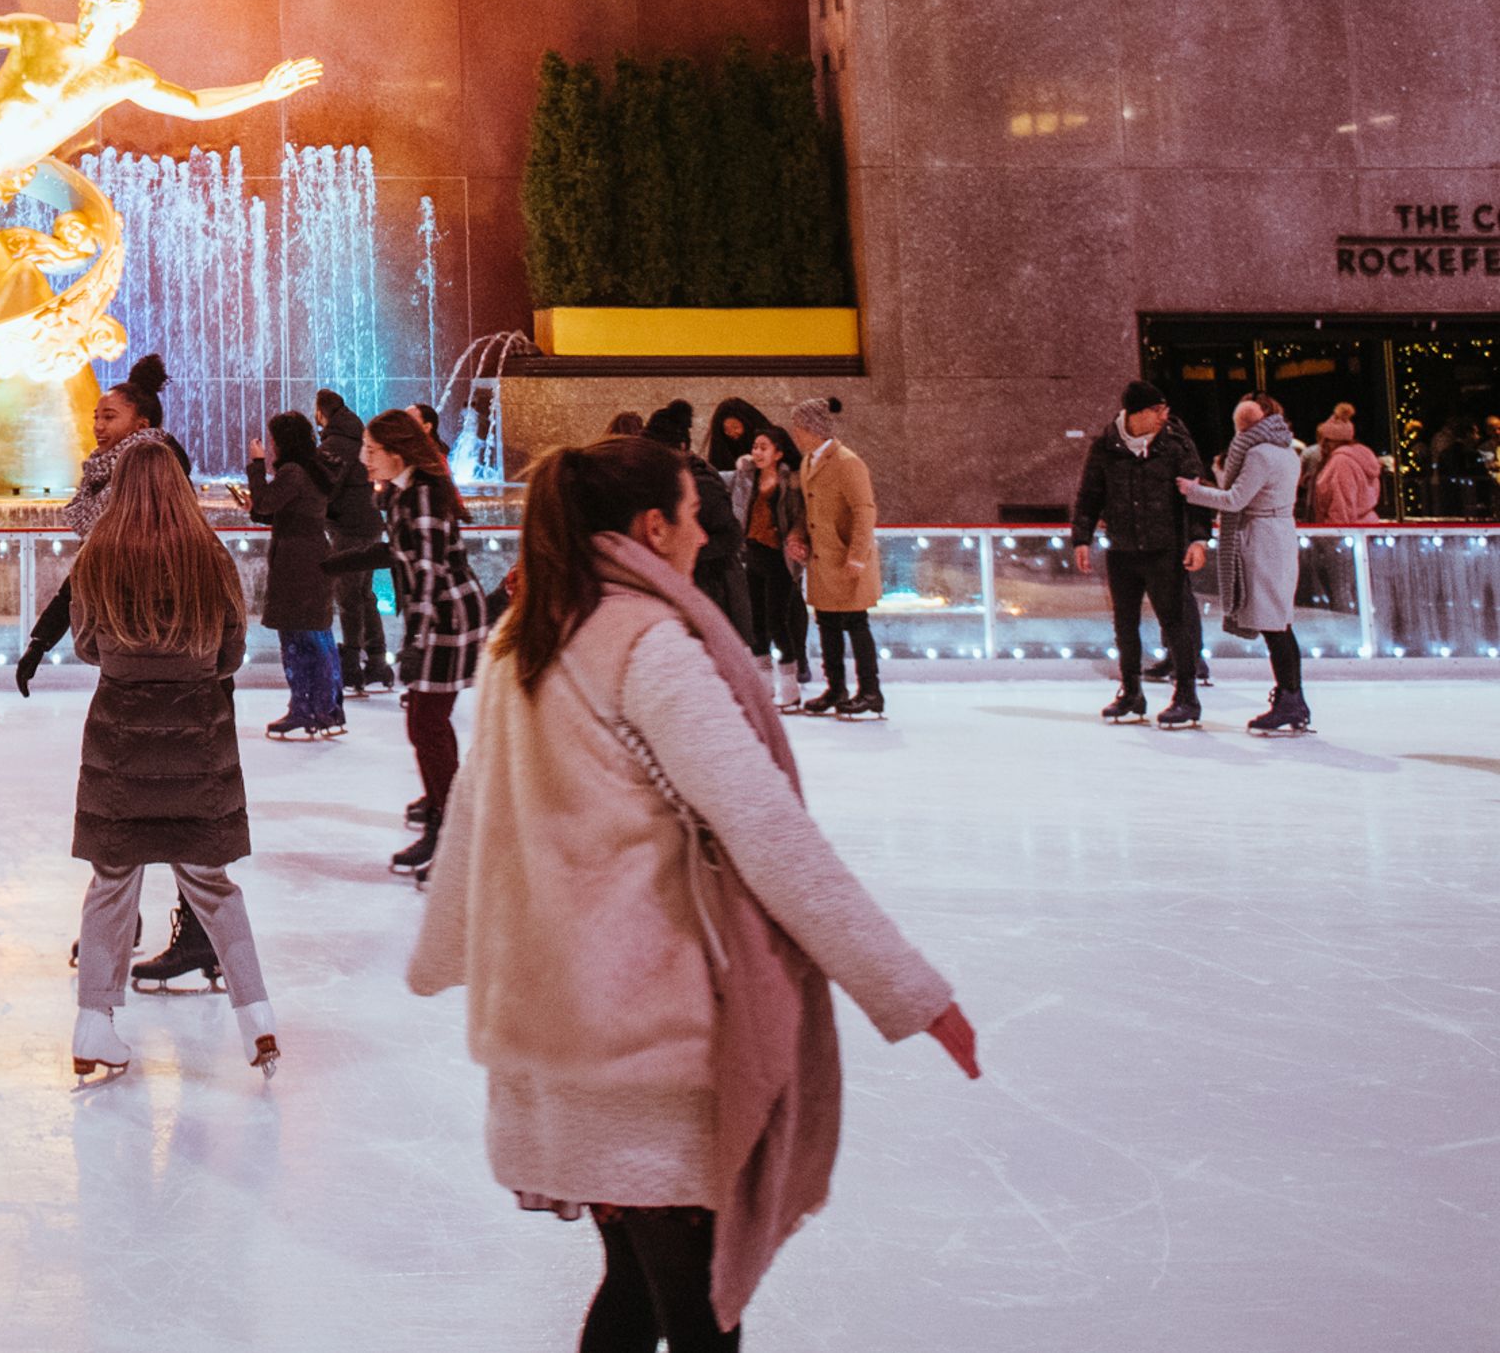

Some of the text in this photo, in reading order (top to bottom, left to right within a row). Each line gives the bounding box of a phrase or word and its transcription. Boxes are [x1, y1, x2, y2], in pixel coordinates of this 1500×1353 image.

[1395, 204, 1500, 233] THE C
[1336, 248, 1500, 276] ROCKEFE
